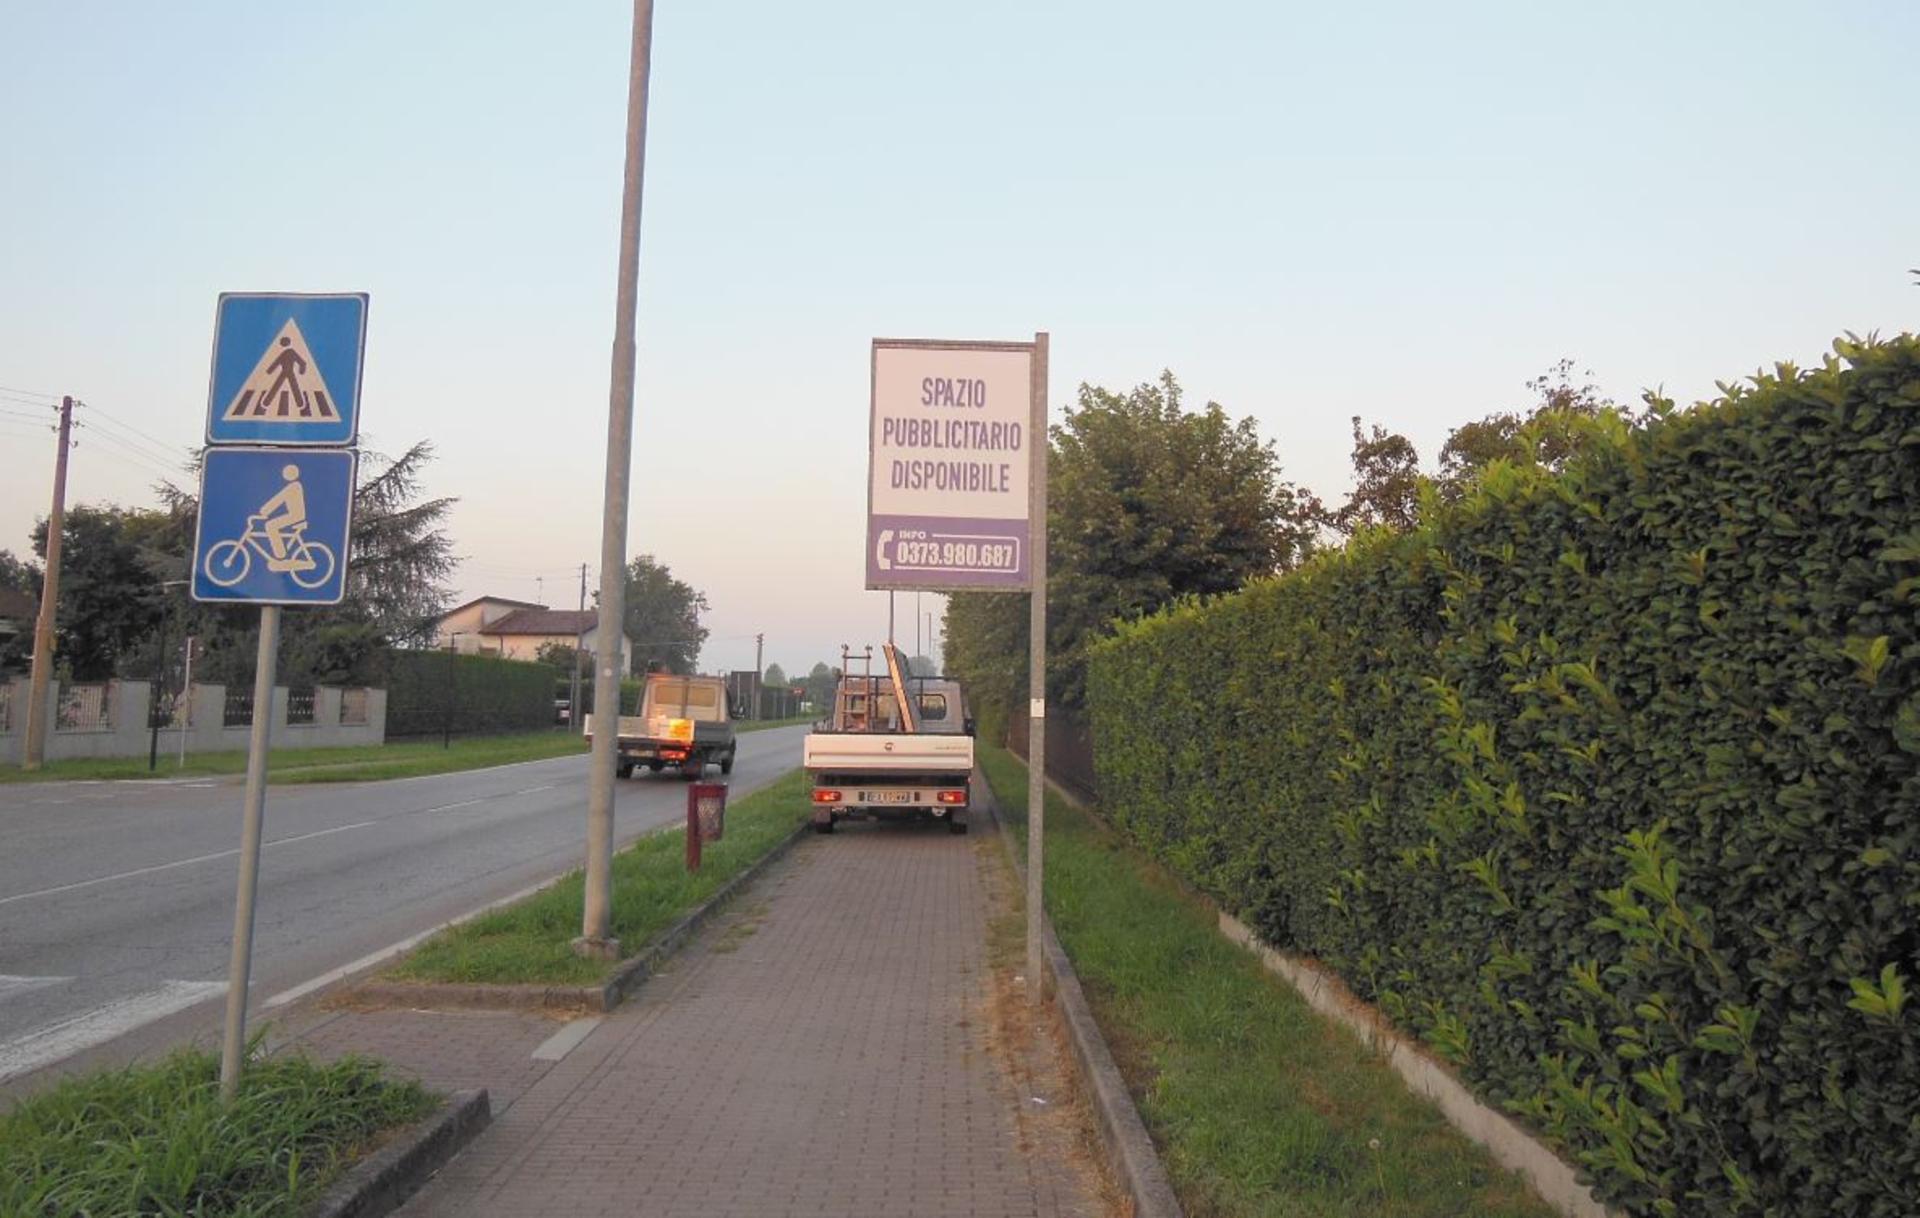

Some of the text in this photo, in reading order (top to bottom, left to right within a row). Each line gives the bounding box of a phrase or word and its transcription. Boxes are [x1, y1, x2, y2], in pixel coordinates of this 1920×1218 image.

[921, 377, 986, 408] SPAZIO
[882, 417, 1022, 451] PUBBLICITARIO
[891, 460, 1010, 493] DISPONIBILE
[899, 530, 927, 540] INFO
[897, 541, 1013, 567] 0373.980.687
